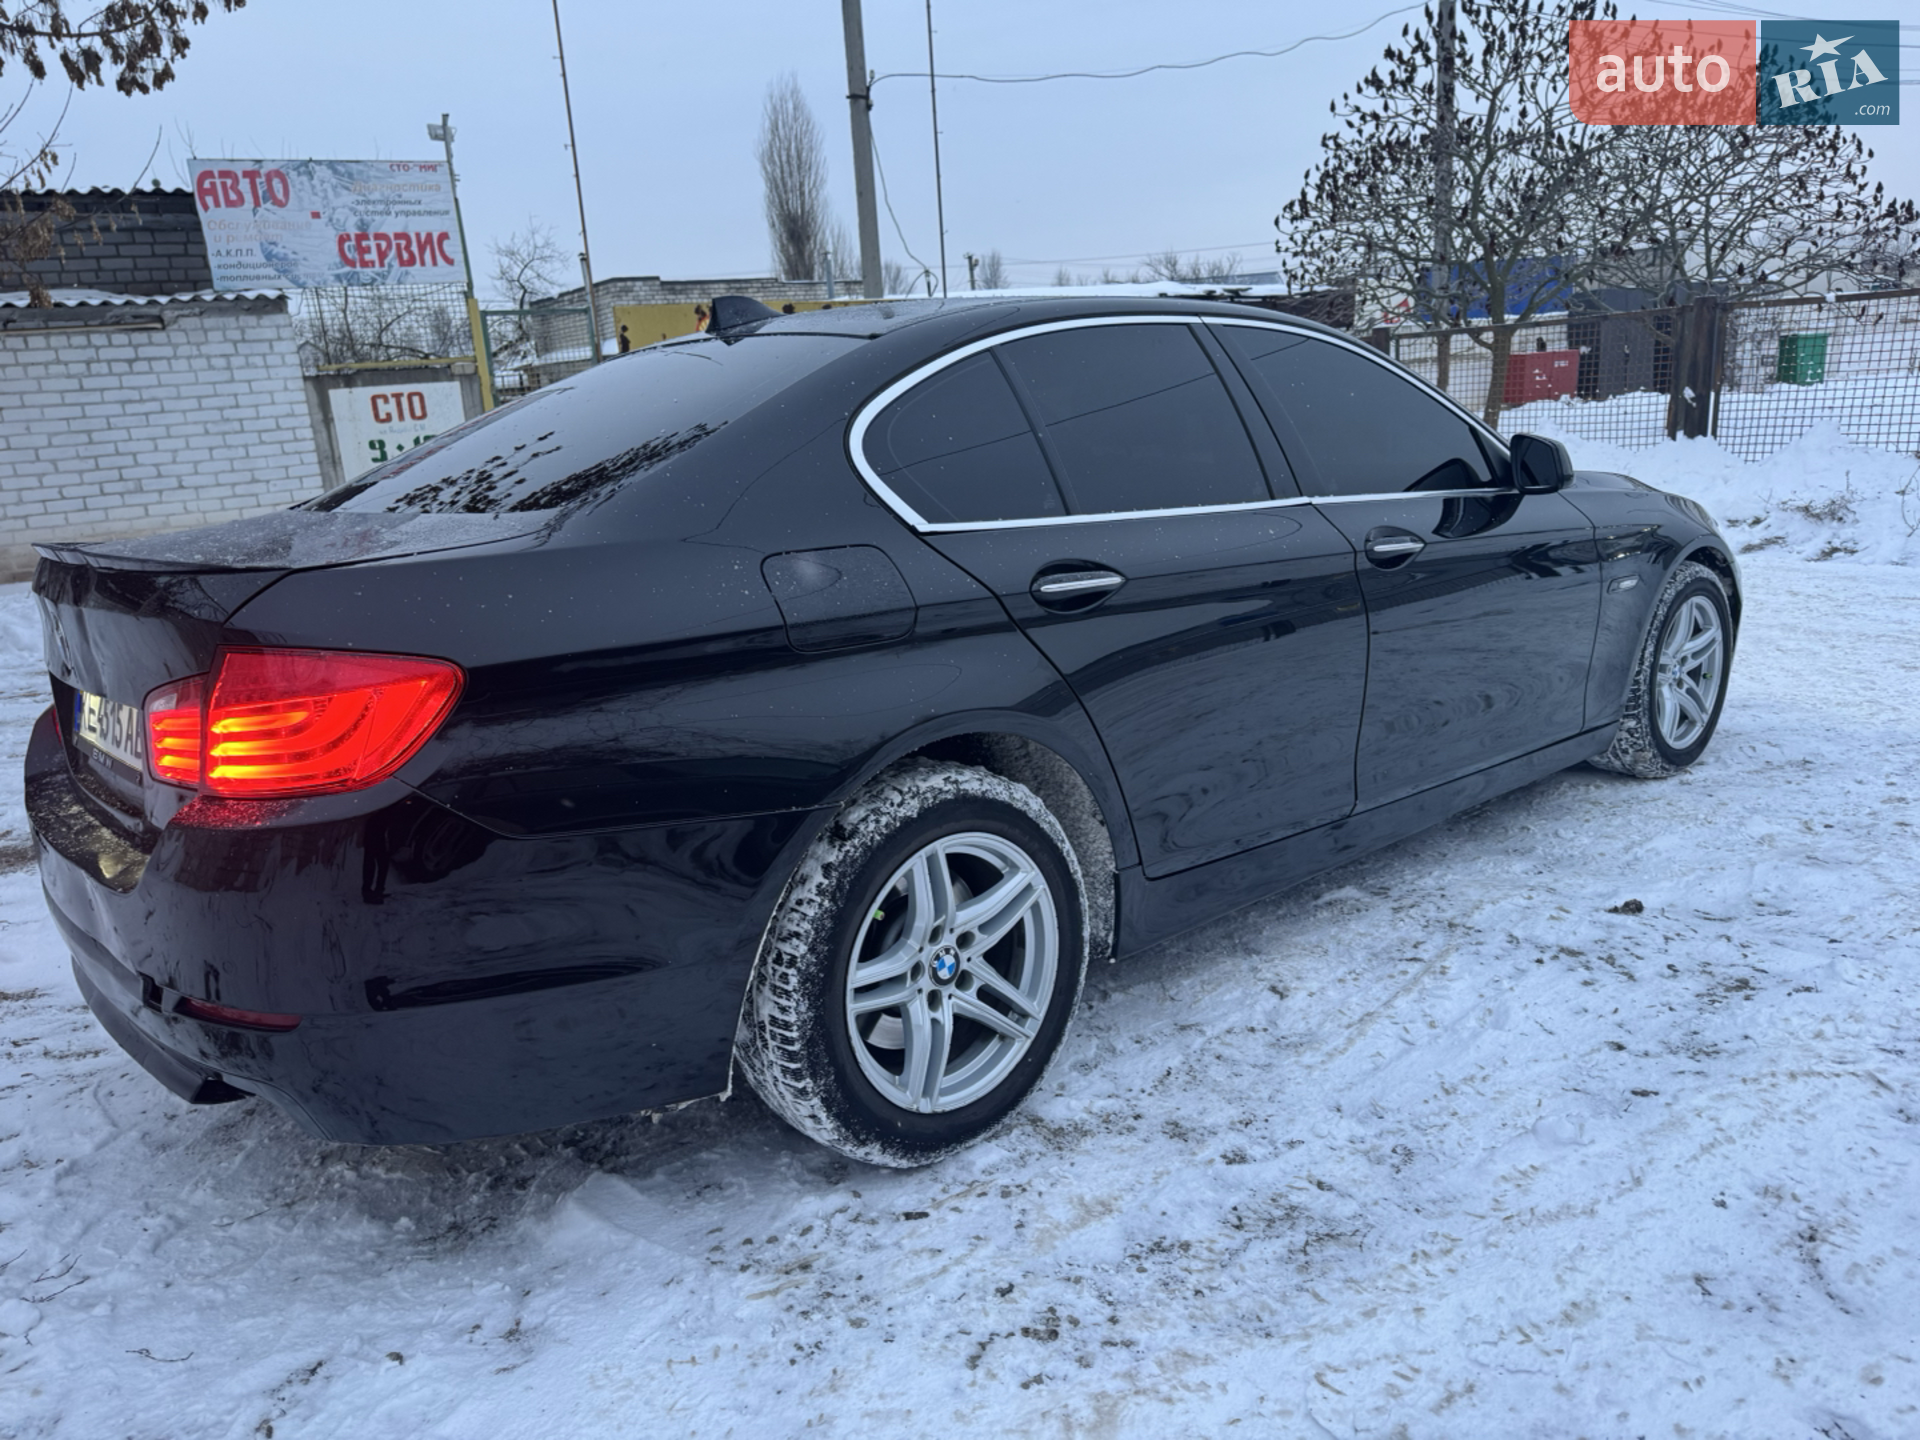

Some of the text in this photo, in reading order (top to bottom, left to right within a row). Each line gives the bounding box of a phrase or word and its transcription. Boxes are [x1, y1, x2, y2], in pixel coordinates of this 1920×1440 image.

[196, 169, 290, 213] АВТО
[337, 231, 455, 269] СЕРВИС
[370, 391, 428, 424] СТО
